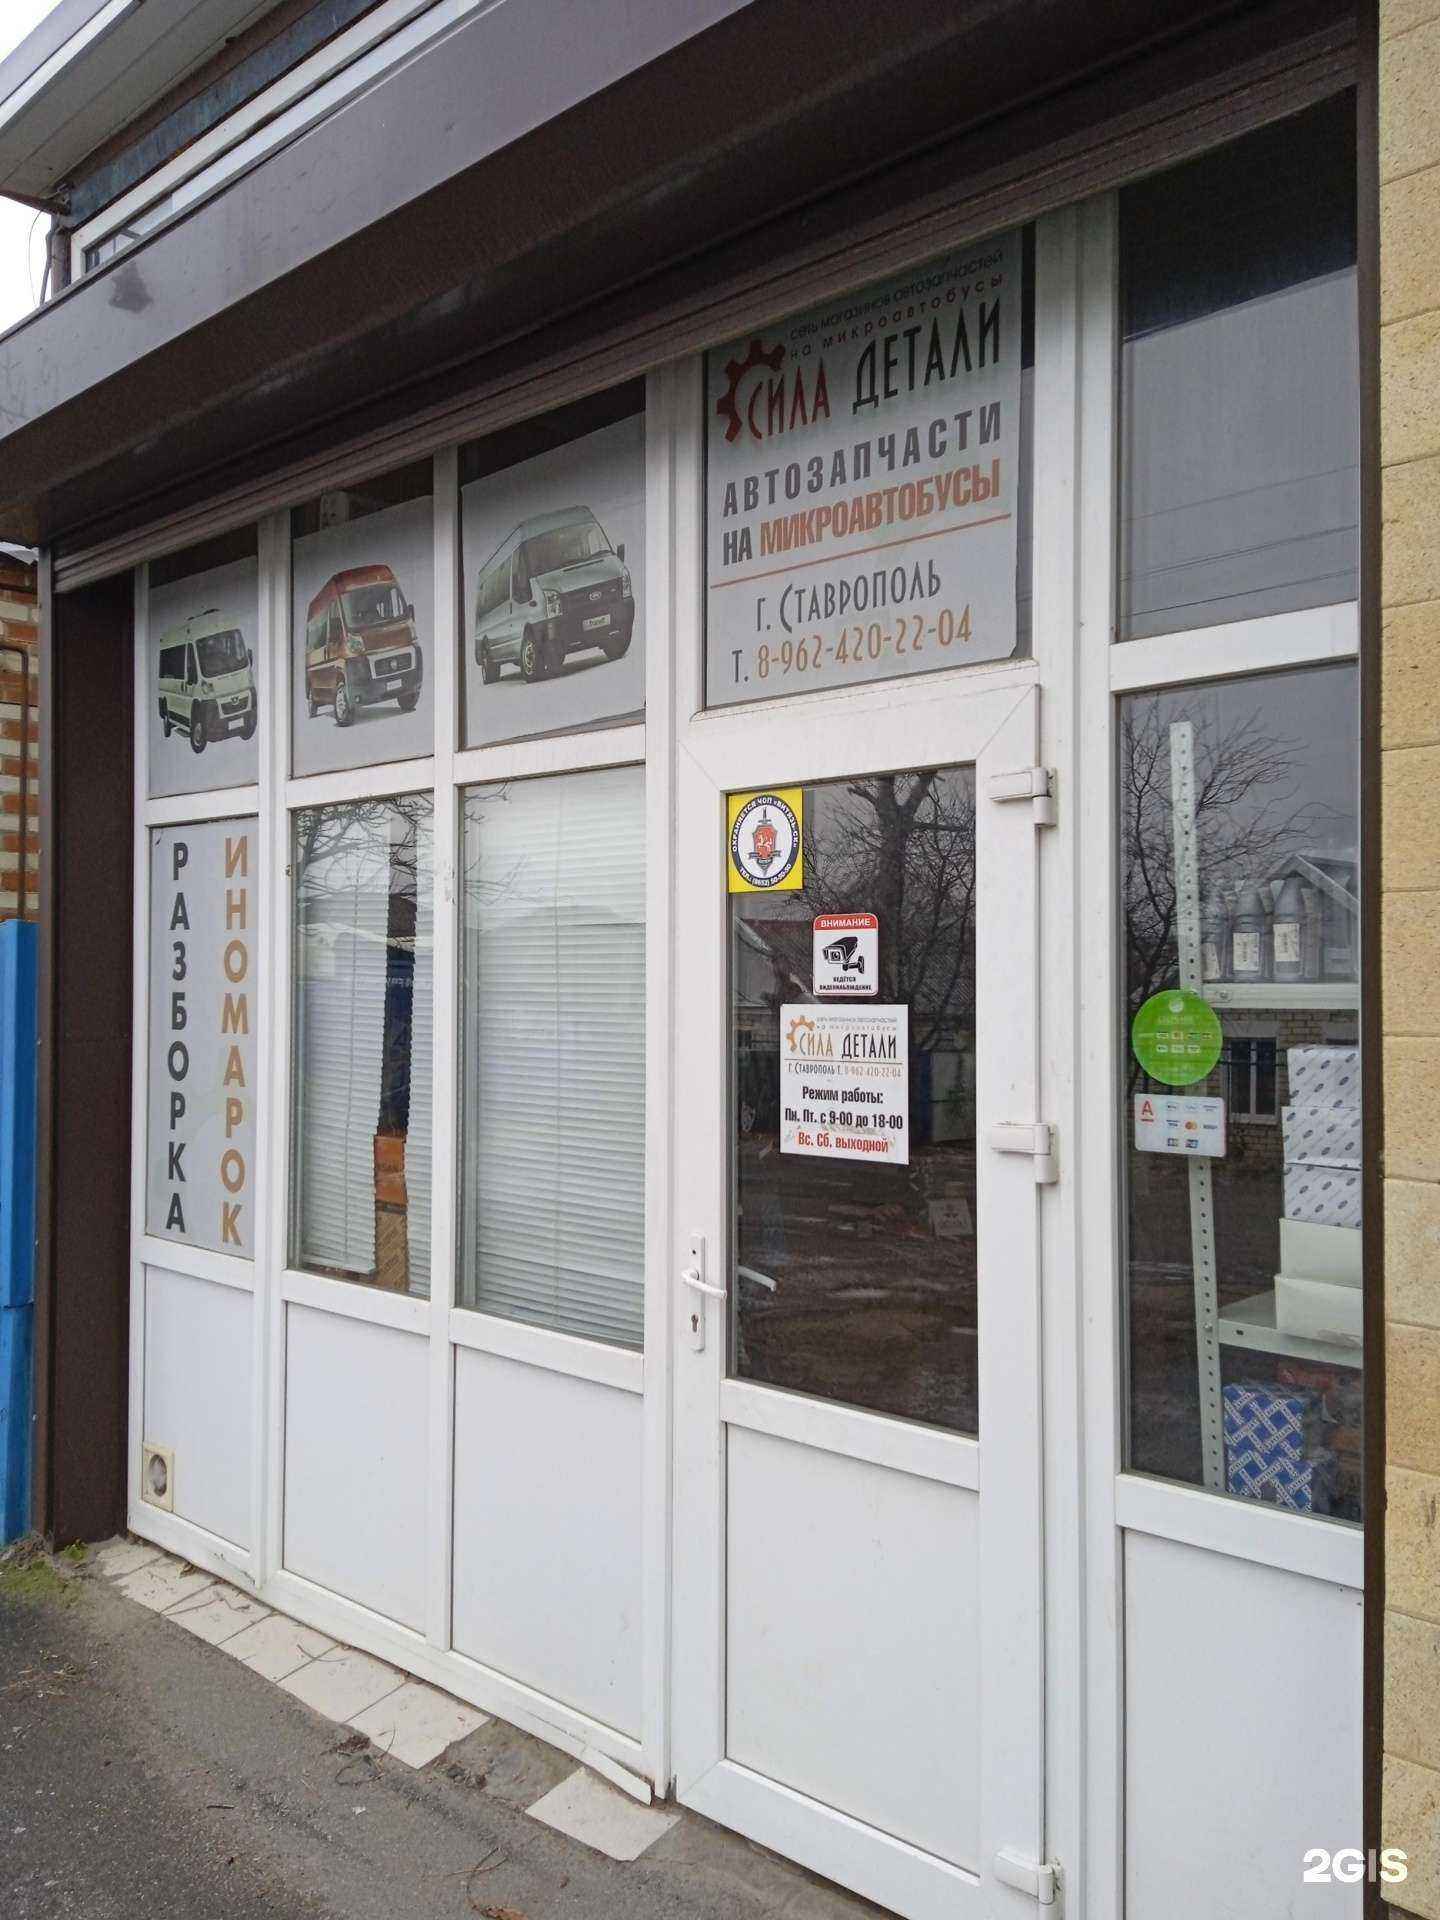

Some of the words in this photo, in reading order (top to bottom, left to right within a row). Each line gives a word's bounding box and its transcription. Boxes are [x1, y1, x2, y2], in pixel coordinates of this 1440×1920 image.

[823, 274, 1003, 350] микроавтобусы
[748, 356, 830, 440] СИЛА
[853, 298, 1000, 416] ДЕТАЛИ
[723, 401, 1001, 518] АВТОЗАПЧАСТИ
[723, 525, 752, 566] НА
[760, 458, 1000, 557] МИКРОАВТОБУСЫ
[780, 559, 941, 634] СТАВРОПОЛЬ
[758, 604, 972, 679] 8-962-420-22-04
[732, 802, 756, 852] ОХРАНЯЕТСЯ
[757, 797, 772, 805] ЧОП
[820, 918, 871, 928] ВНИМАНИЕ
[165, 841, 190, 1234] РАЗБОРКА
[220, 836, 249, 1247] ИНОМАРОК
[799, 1032, 834, 1057] СИЛА
[842, 1032, 897, 1059] ДЕТАЛИ
[785, 1108, 800, 1122] Пн.
[803, 1109, 817, 1123] Пт.
[820, 1113, 826, 1124] с
[829, 1110, 853, 1126] 9-00
[855, 1115, 869, 1127] до
[873, 1113, 903, 1130] 18-00
[802, 1086, 839, 1101] Режим
[841, 1087, 884, 1105] работы:
[798, 1132, 814, 1146] Вс.
[816, 1133, 832, 1148] Сб.
[835, 1136, 889, 1153] выходной
